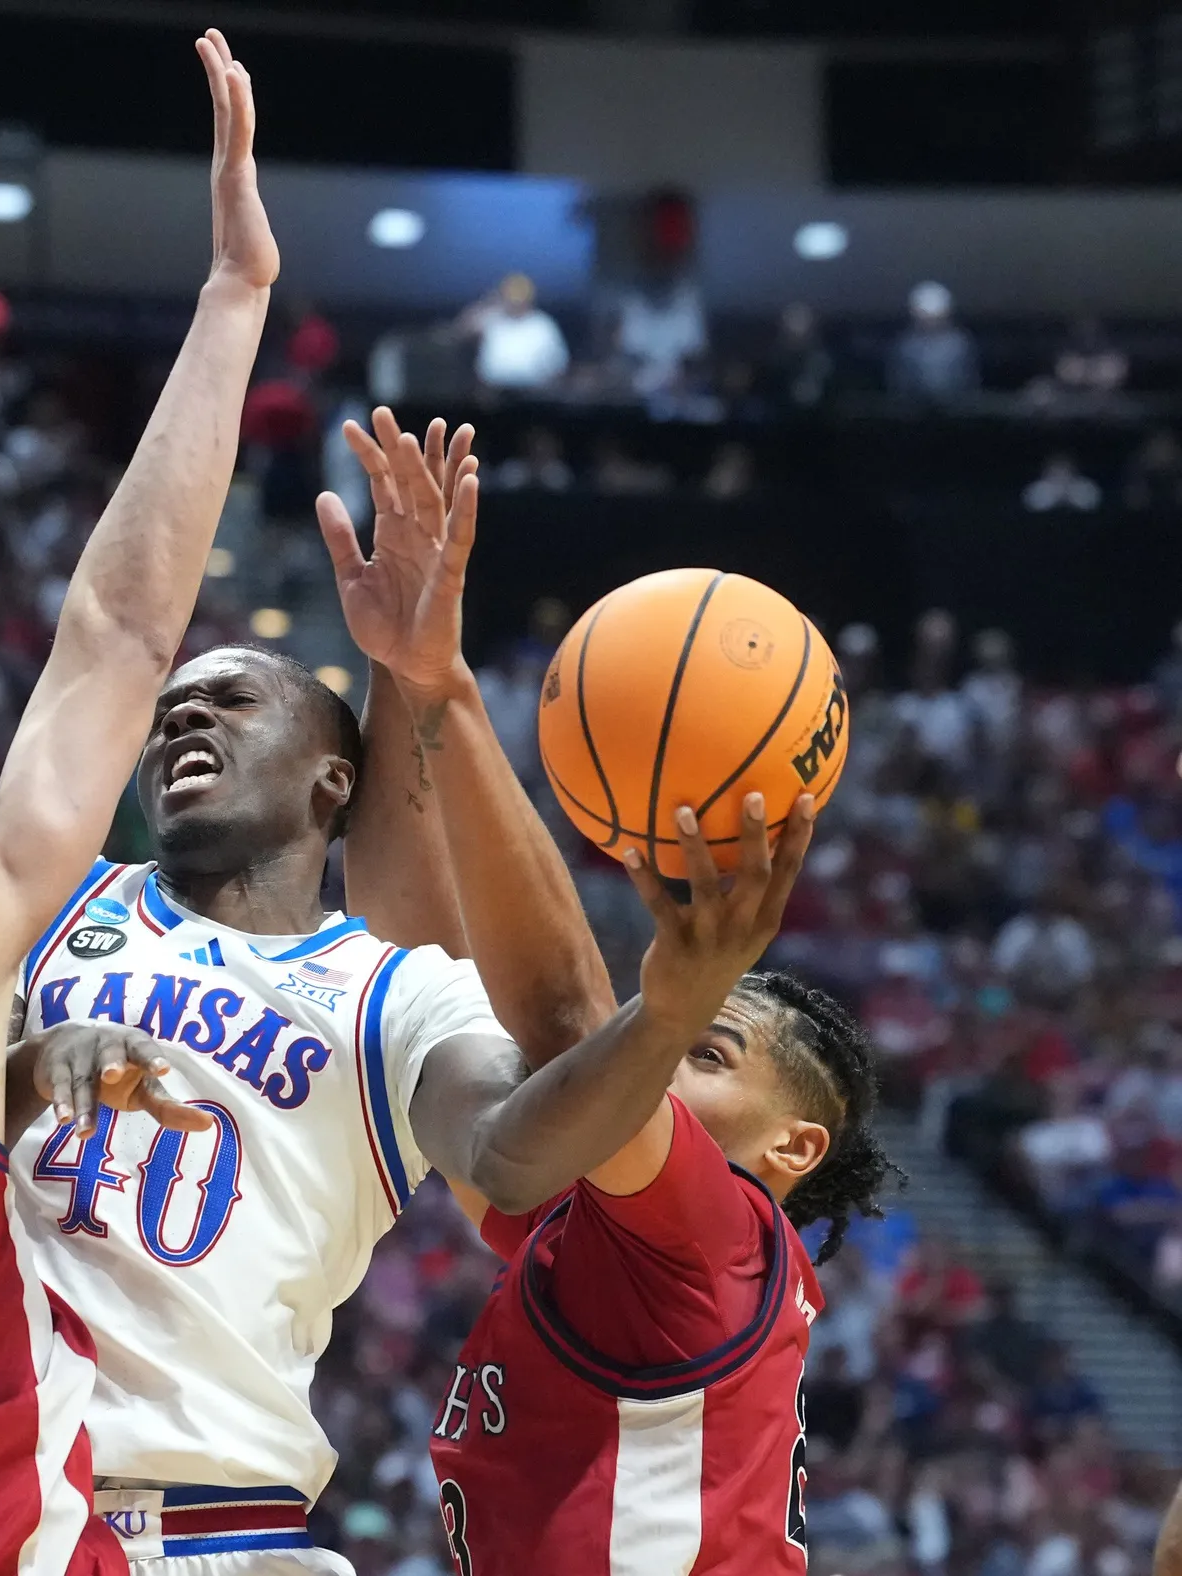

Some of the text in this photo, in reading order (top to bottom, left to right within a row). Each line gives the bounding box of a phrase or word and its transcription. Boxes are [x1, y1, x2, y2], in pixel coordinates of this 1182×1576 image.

[72, 930, 122, 951] SW
[39, 972, 333, 1110] KANSAS
[33, 1099, 243, 1268] 40
[103, 1510, 147, 1539] KU
